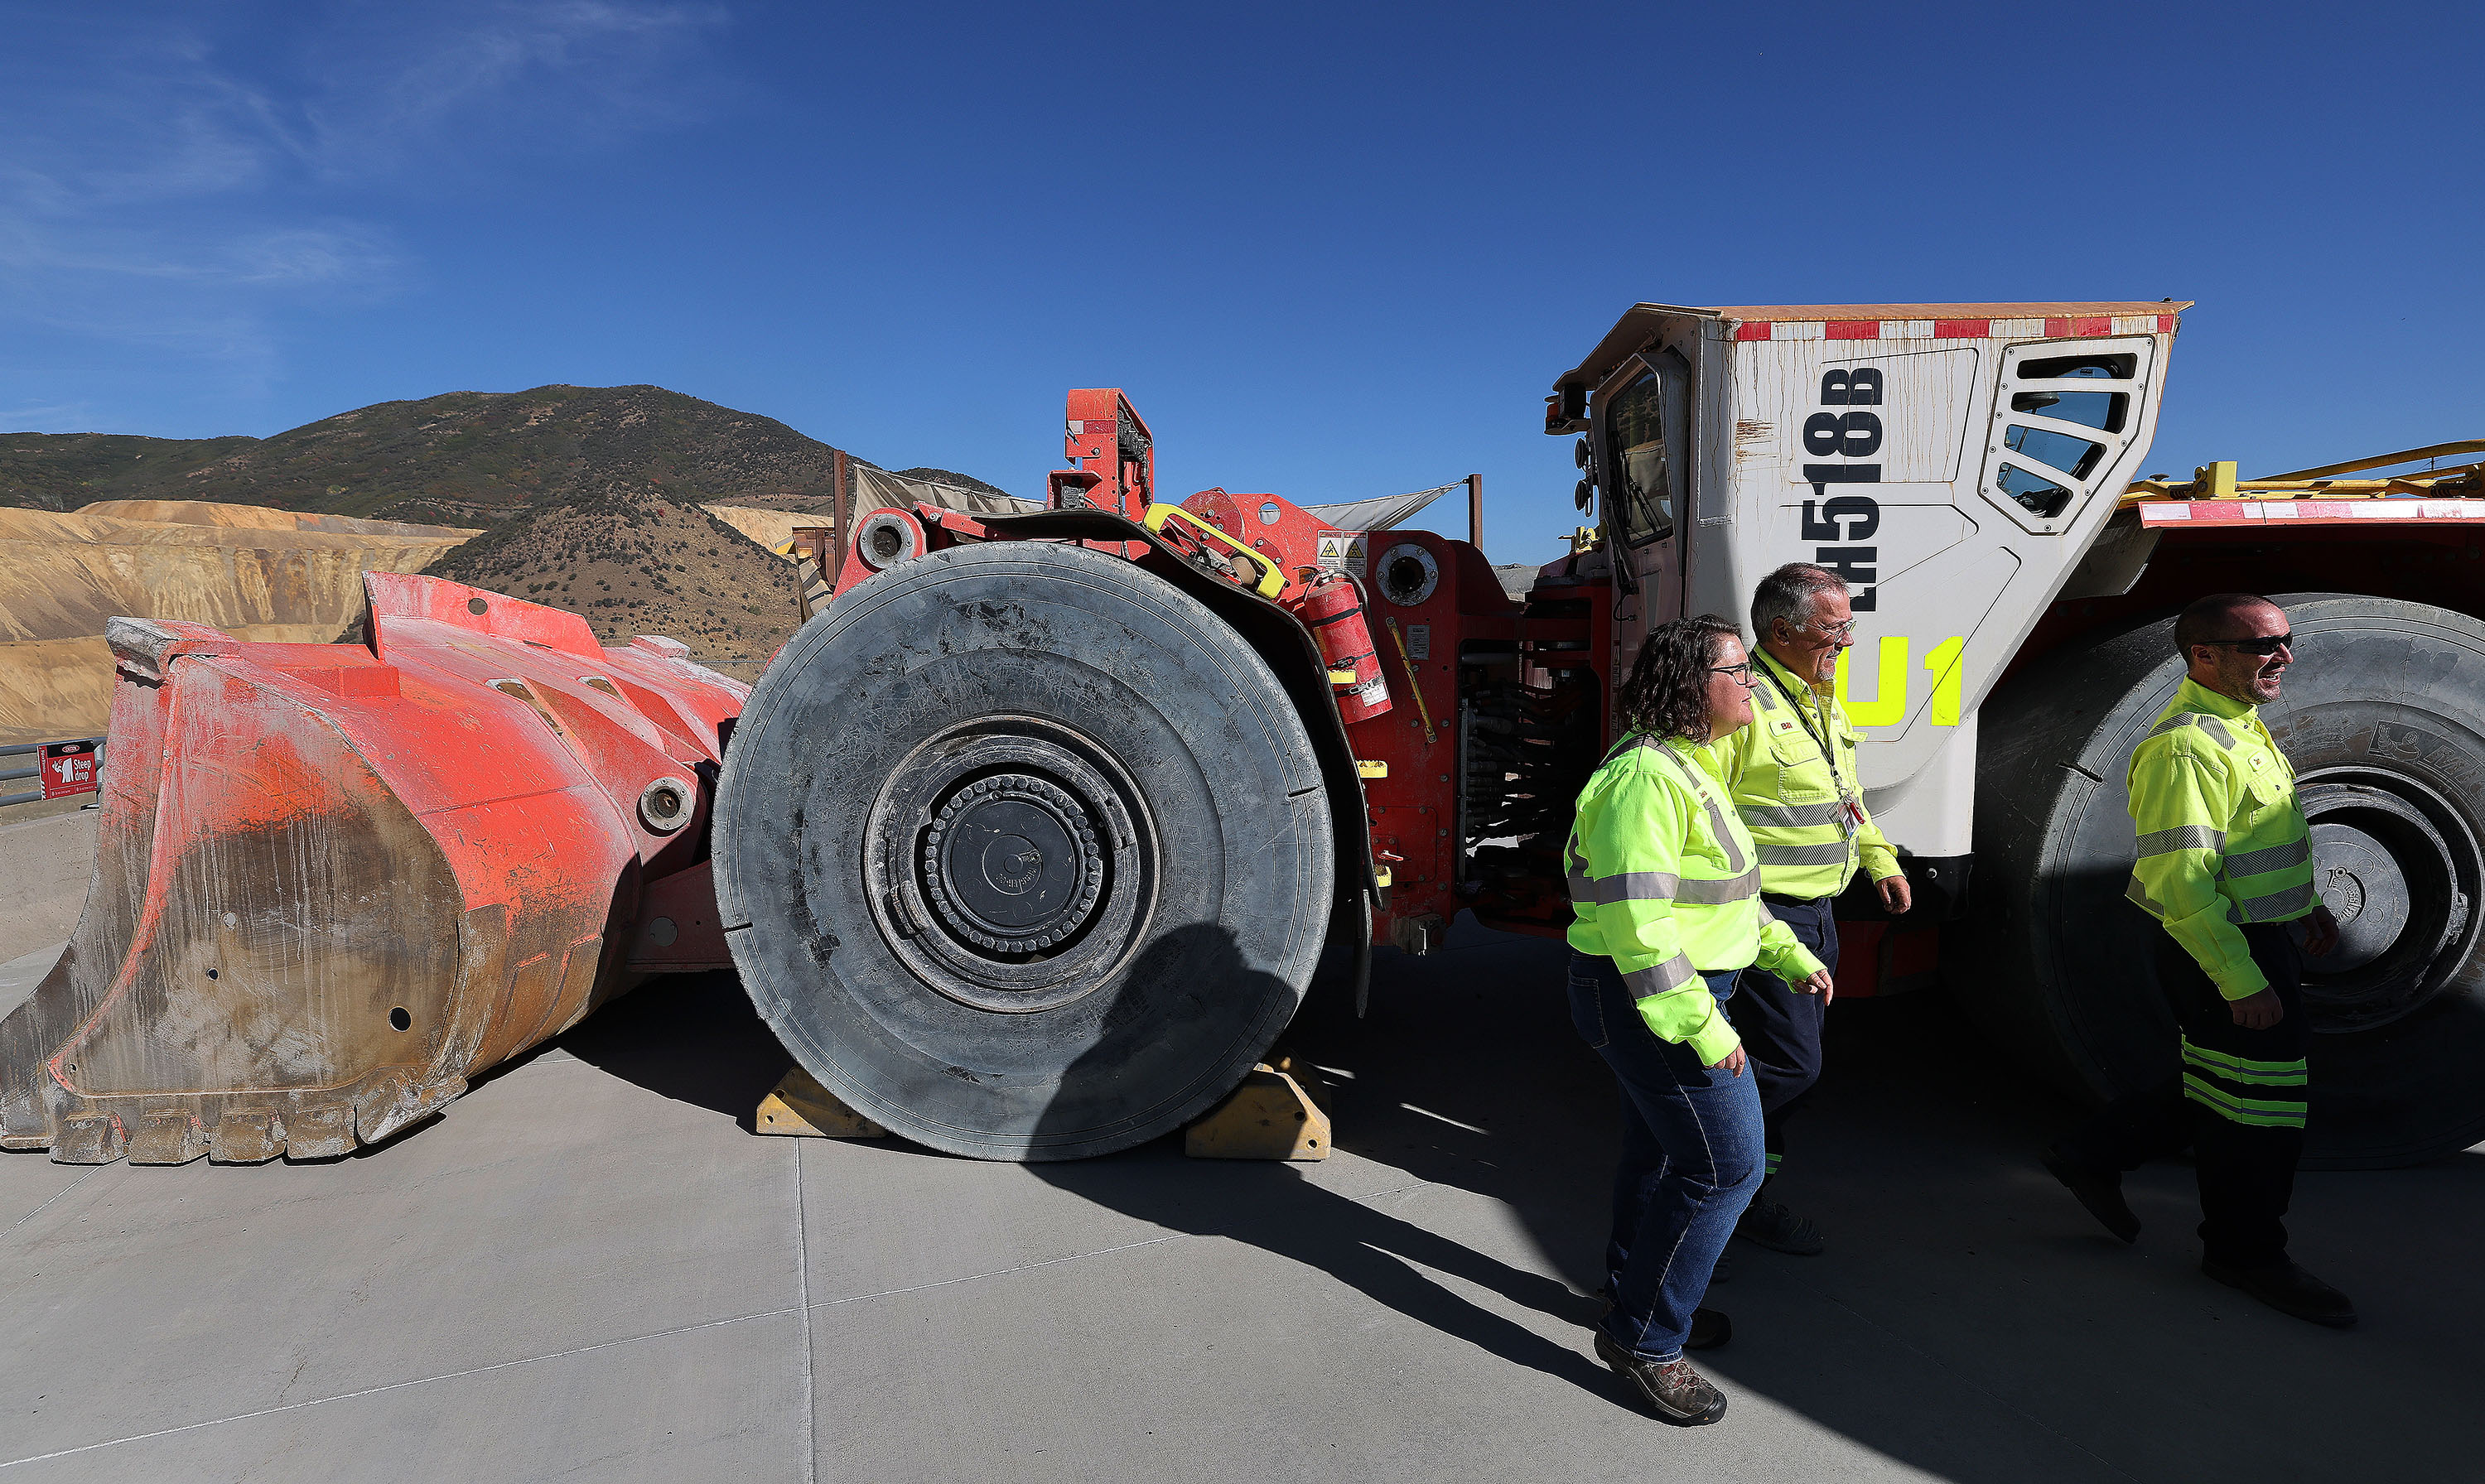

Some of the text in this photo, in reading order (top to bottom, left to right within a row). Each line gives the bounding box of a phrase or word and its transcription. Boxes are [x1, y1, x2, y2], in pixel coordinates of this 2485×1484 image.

[1801, 367, 1883, 612] LH518B
[73, 759, 92, 771] Steep
[75, 770, 89, 782] drop
